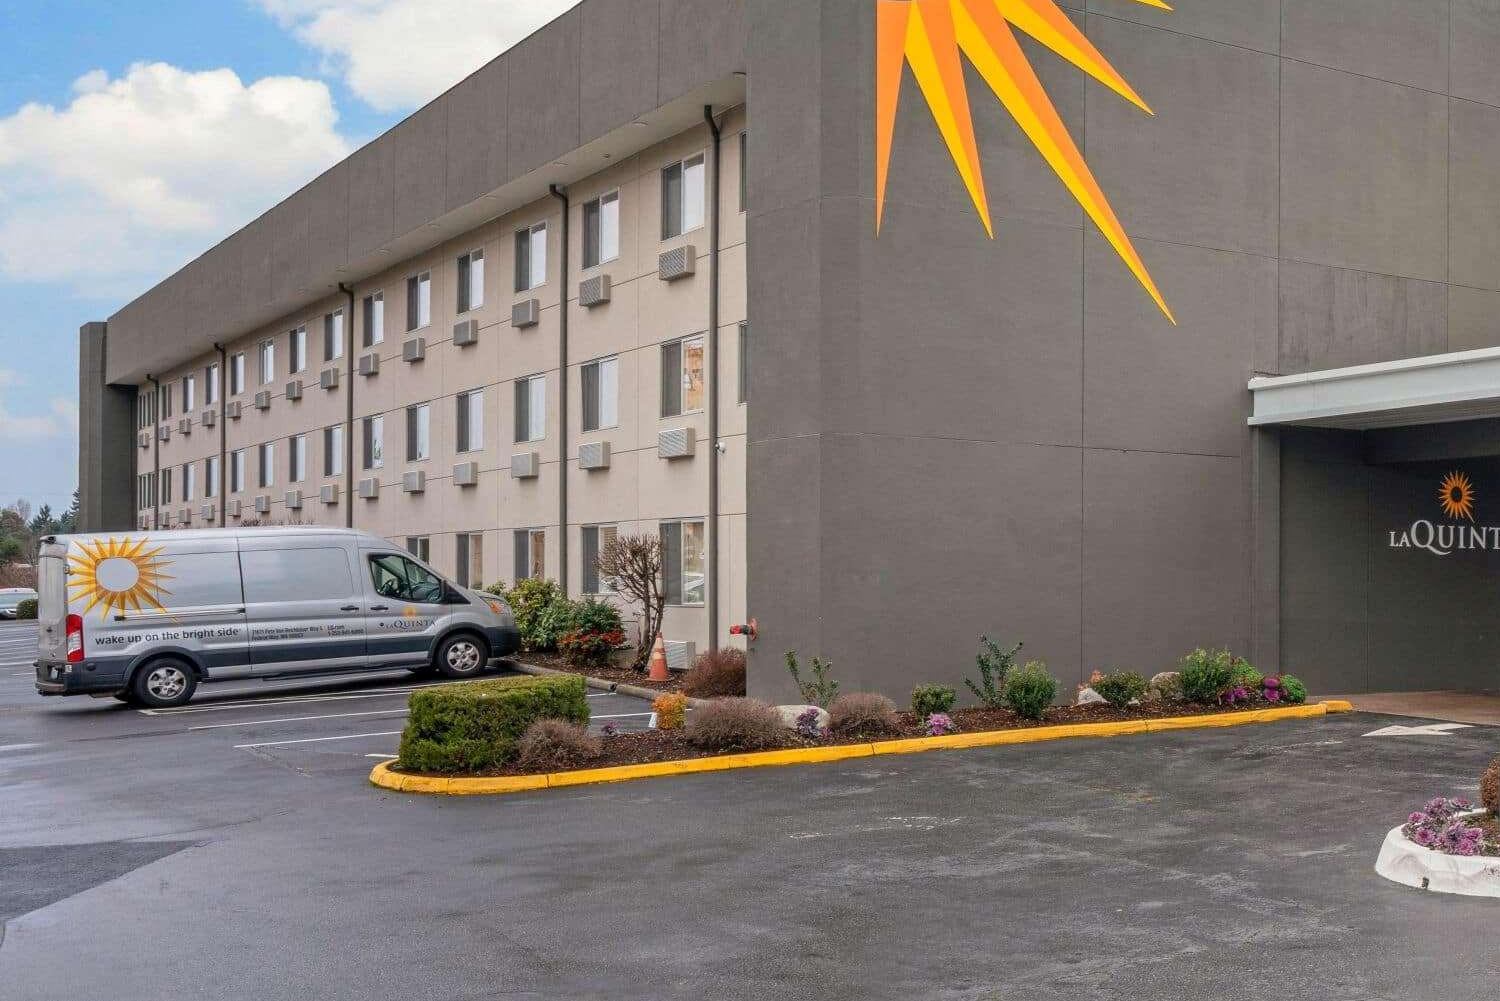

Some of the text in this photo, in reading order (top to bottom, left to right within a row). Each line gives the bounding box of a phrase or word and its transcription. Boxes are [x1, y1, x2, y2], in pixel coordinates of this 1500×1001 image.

[95, 634, 125, 645] wake
[127, 635, 142, 644] up
[145, 632, 159, 641] on
[162, 630, 180, 640] the
[182, 627, 215, 639] bright
